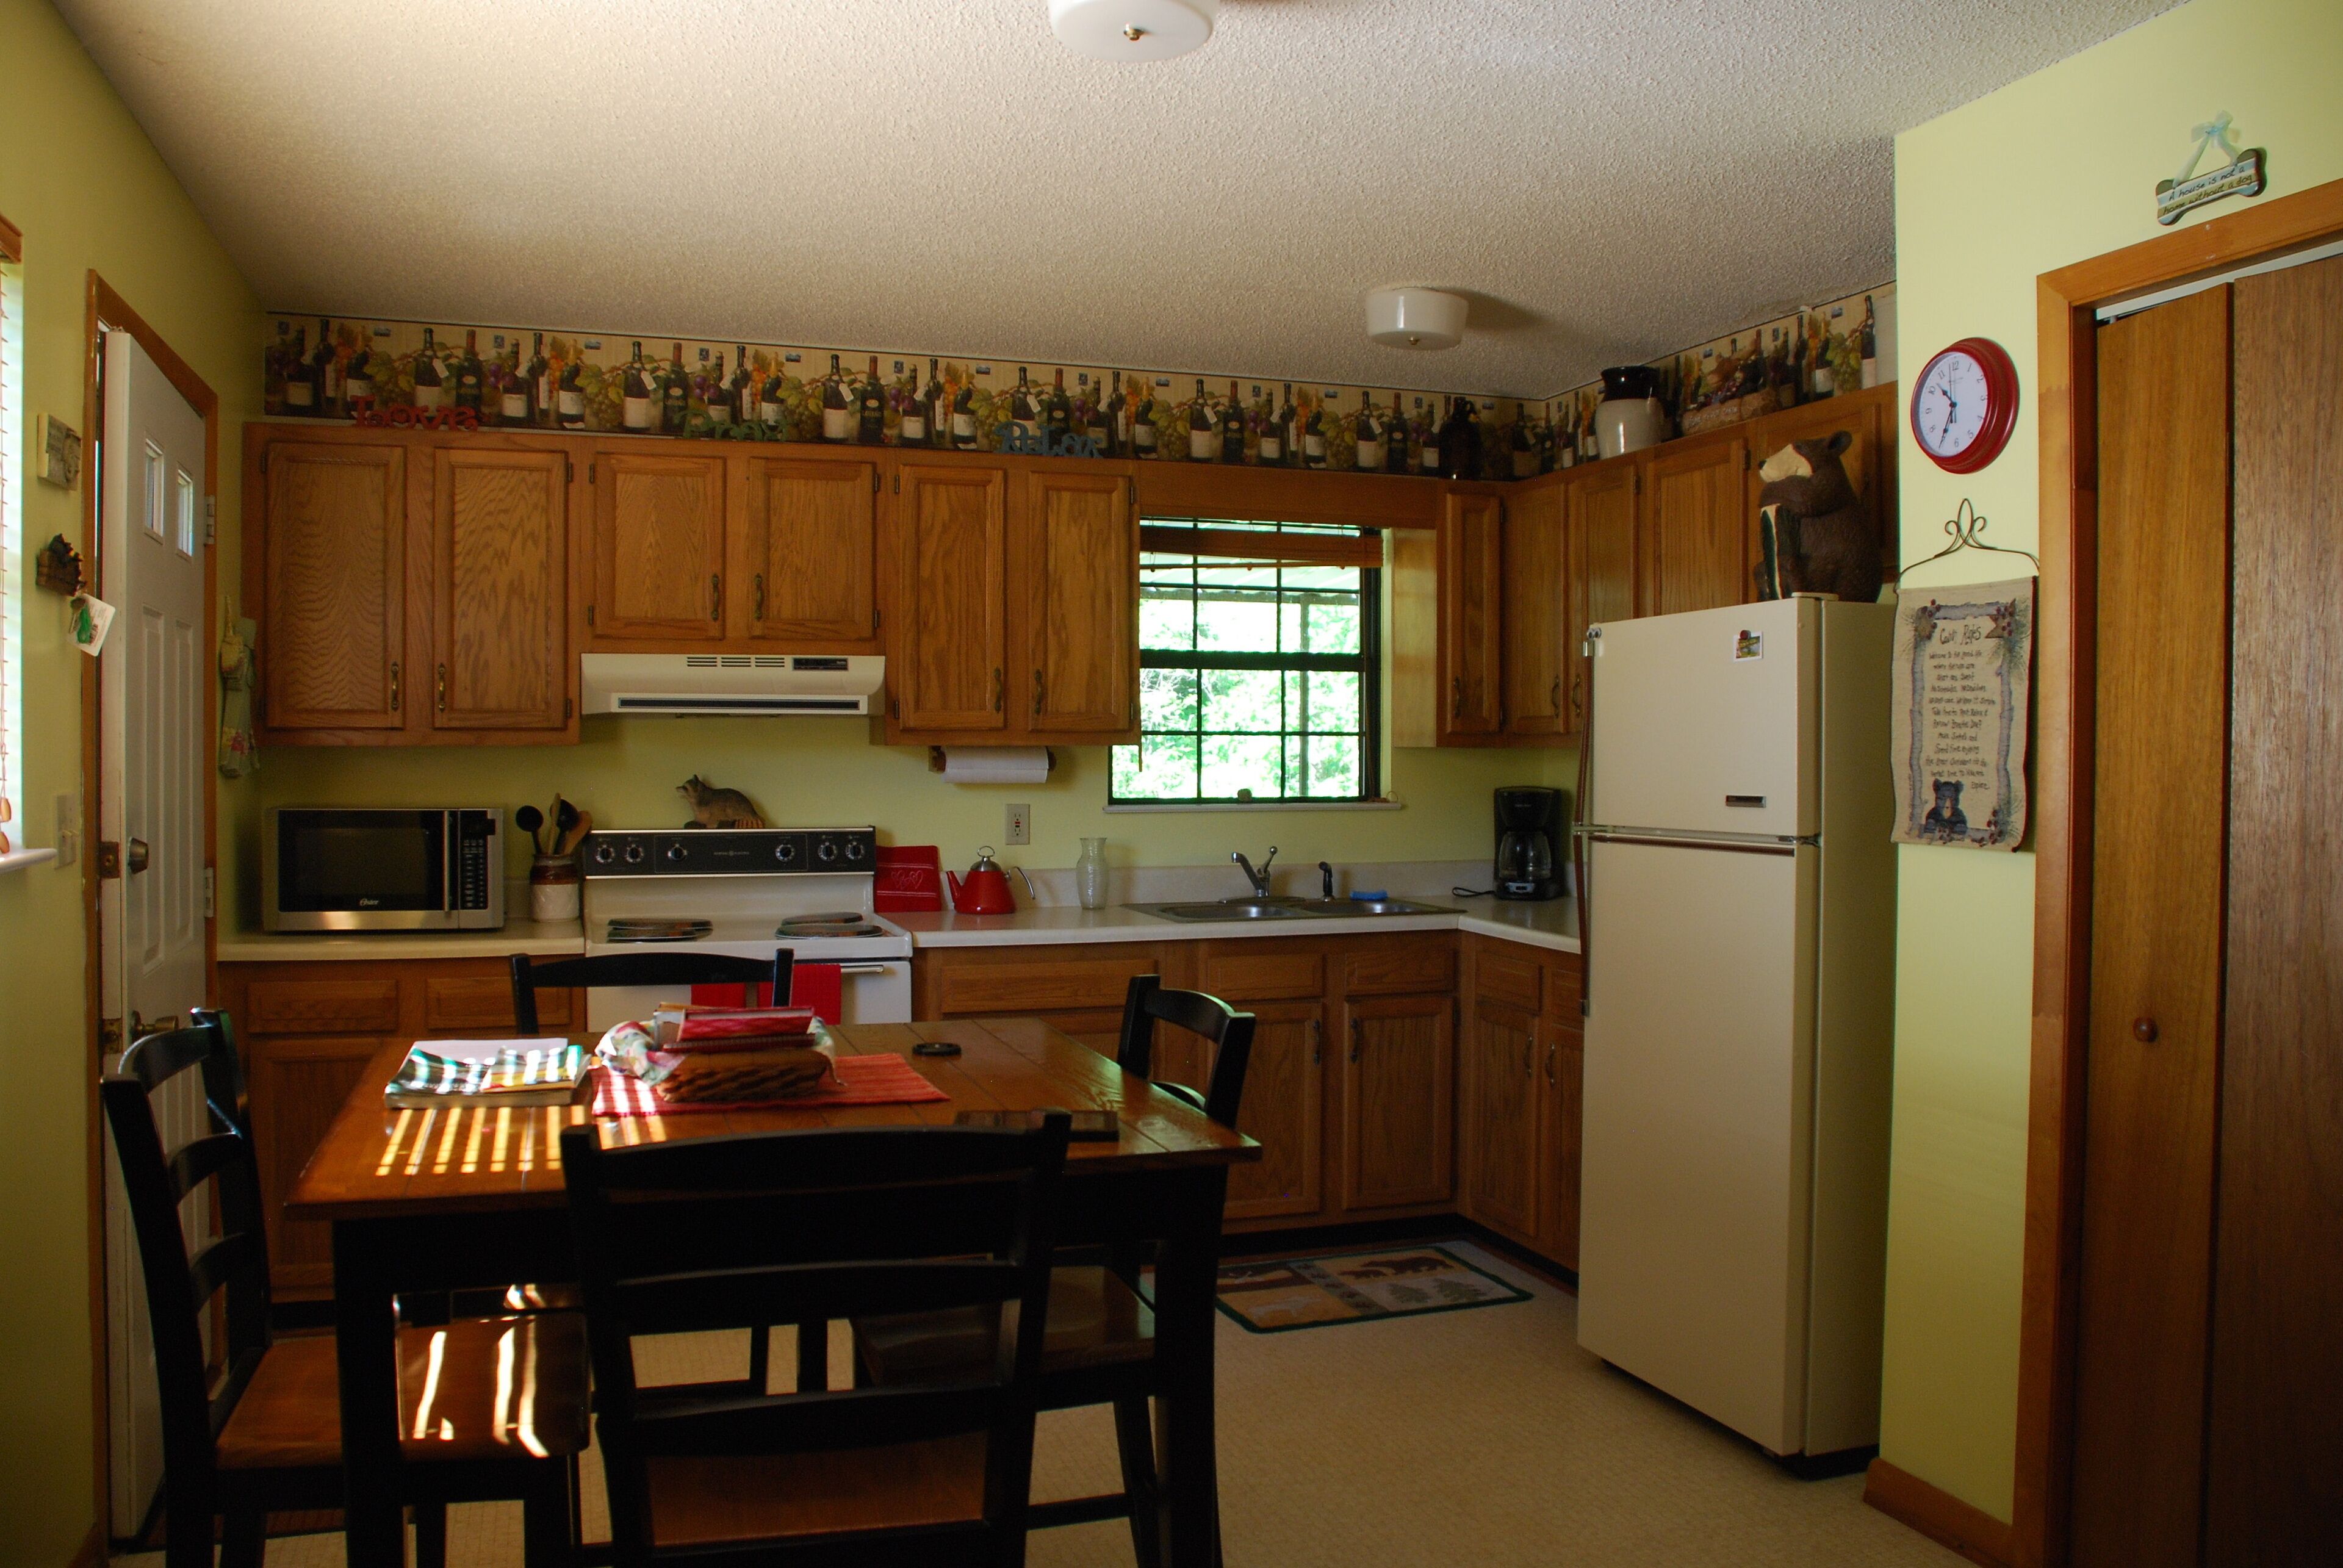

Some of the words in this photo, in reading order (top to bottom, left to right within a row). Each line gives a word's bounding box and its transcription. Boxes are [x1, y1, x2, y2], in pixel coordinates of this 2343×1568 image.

[2168, 190, 2175, 201] A
[2178, 181, 2205, 198] house
[2208, 176, 2217, 185] is
[2220, 167, 2236, 181] not
[2239, 165, 2245, 174] a
[2164, 202, 2186, 214] home
[2189, 184, 2225, 205] without
[2228, 181, 2234, 190] a
[2236, 174, 2253, 185] dog
[1952, 360, 1959, 371] 12
[1967, 362, 1972, 372] 1
[1937, 370, 1945, 379] 11
[1976, 374, 1984, 383] 2
[1927, 386, 1935, 395] 10
[350, 394, 478, 431] Love
[1929, 425, 1936, 433] 8
[1967, 430, 1974, 439] 5
[1954, 437, 1959, 448] 6
